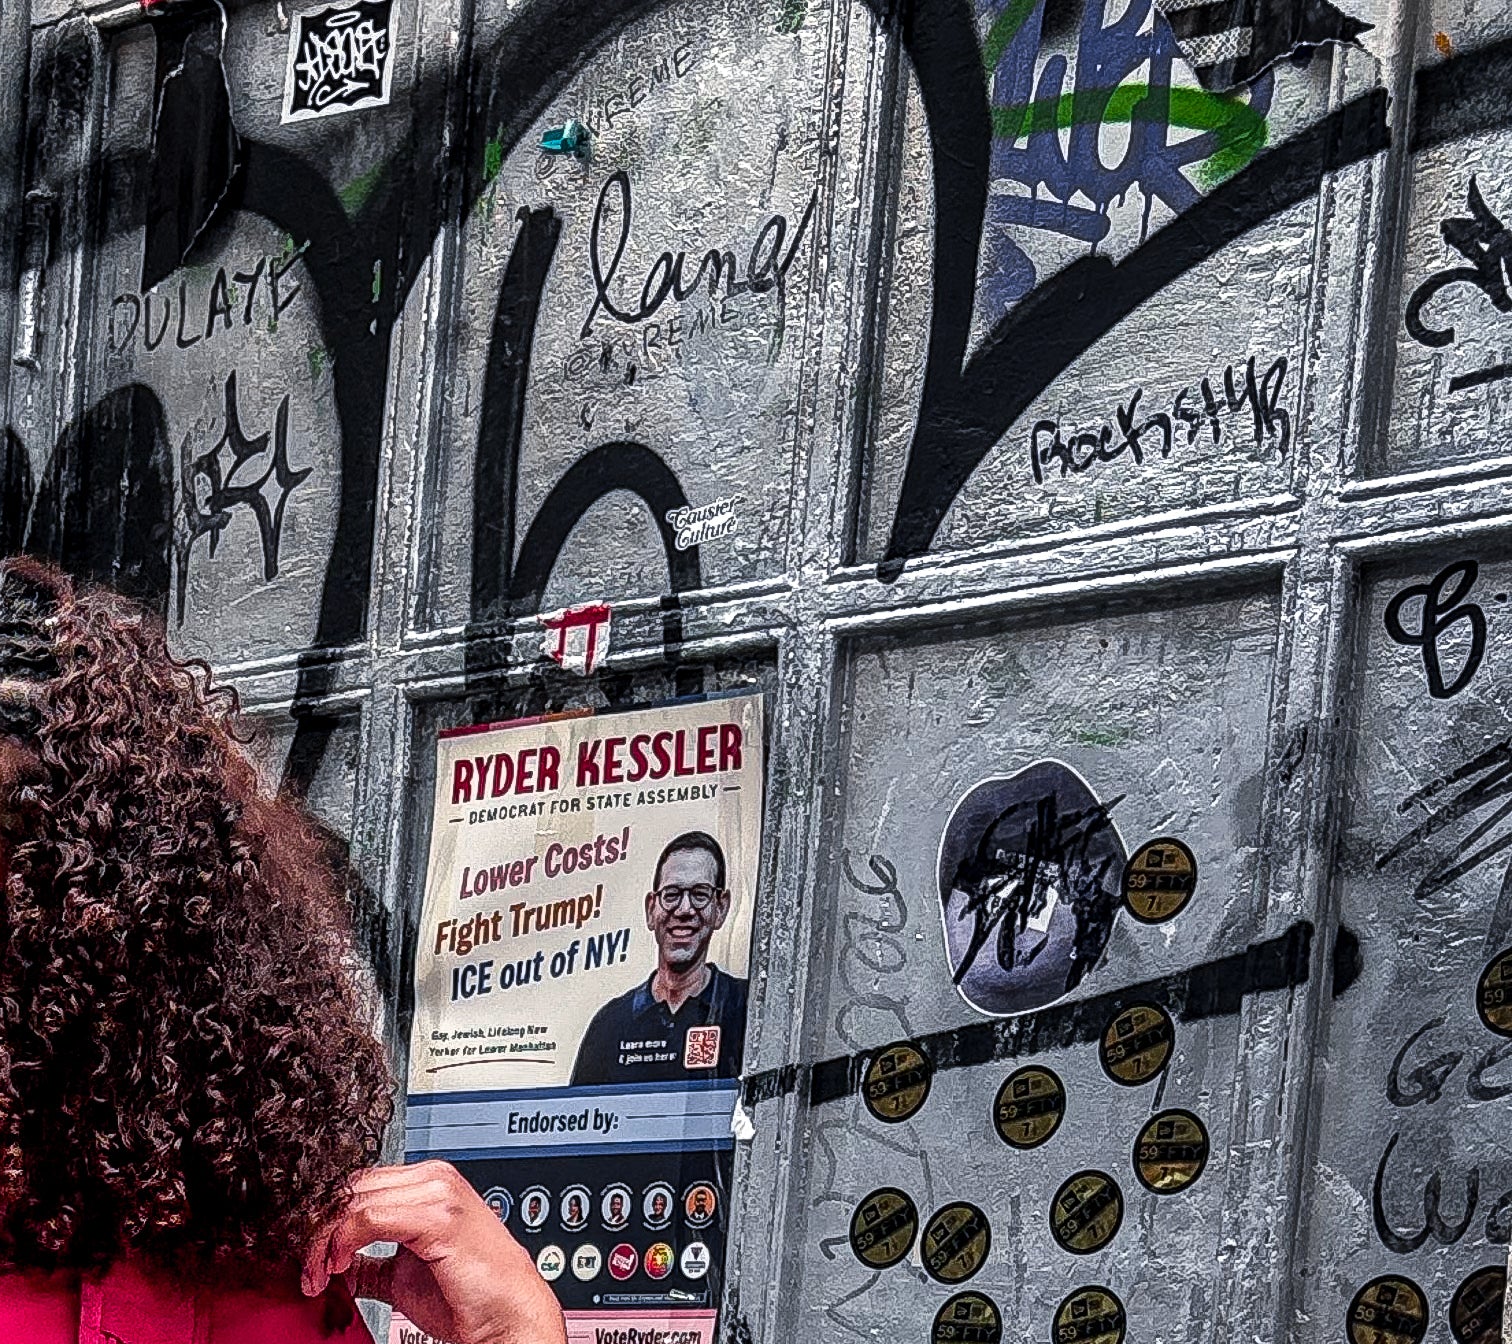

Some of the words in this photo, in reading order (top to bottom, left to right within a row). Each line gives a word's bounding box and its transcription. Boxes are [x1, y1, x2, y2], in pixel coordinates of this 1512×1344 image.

[677, 516, 737, 550] Culture
[451, 745, 561, 805] RYDER
[576, 723, 743, 787] KESSLER
[468, 801, 546, 825] DEMOCRAT
[550, 797, 582, 815] FOR
[586, 792, 632, 811] STATE
[637, 782, 719, 806] ASSEMBLY
[459, 854, 538, 900] Lower
[544, 826, 631, 879] Costs!
[434, 912, 502, 956] Fight
[508, 884, 604, 939] Trump!
[451, 959, 494, 1002] ICE
[499, 957, 544, 991] out
[550, 939, 580, 979] of
[584, 928, 631, 972] NY!
[507, 1109, 588, 1134] Endorsed
[592, 1107, 619, 1133] by:
